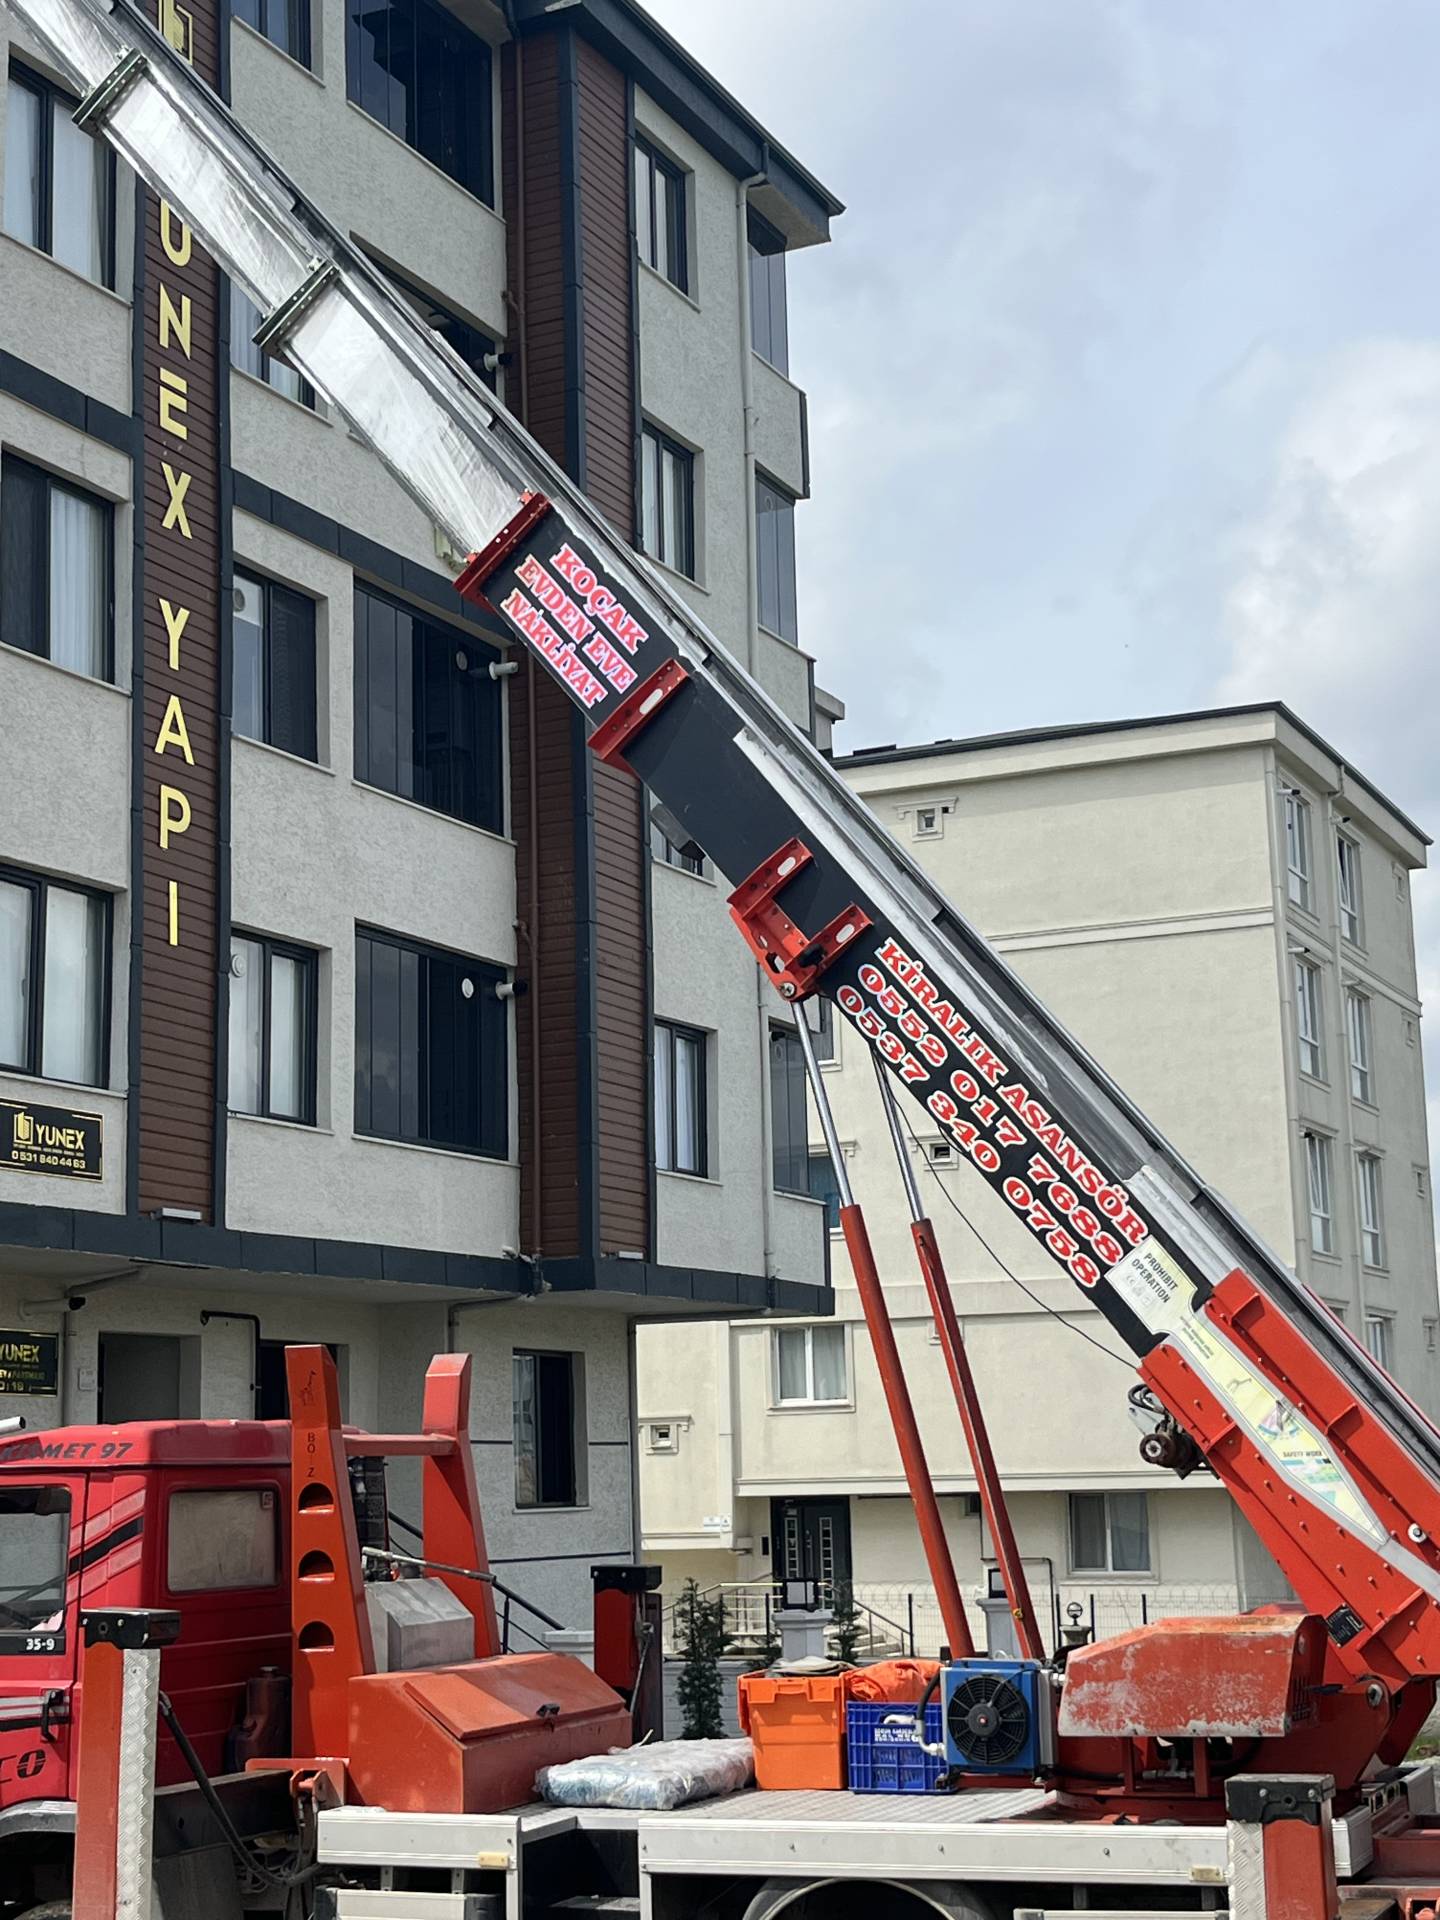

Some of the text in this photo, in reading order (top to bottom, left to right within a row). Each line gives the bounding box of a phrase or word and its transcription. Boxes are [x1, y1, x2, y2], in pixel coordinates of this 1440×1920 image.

[154, 198, 195, 947] UNEX YAPI
[514, 554, 638, 694] EVDEN EVE
[550, 543, 649, 655] KOÇAK
[500, 588, 608, 709] NAKLİYAT
[35, 1124, 85, 1150] YUNEX
[836, 984, 1101, 1288] 0537 340 0758
[858, 963, 1124, 1266] 0552 017 7688
[874, 937, 1151, 1247] KİRALIK ASANSÖR
[1131, 1258, 1171, 1303] OPERATION
[1144, 1253, 1178, 1291] PROHIBIT
[101, 1443, 133, 1459] 97
